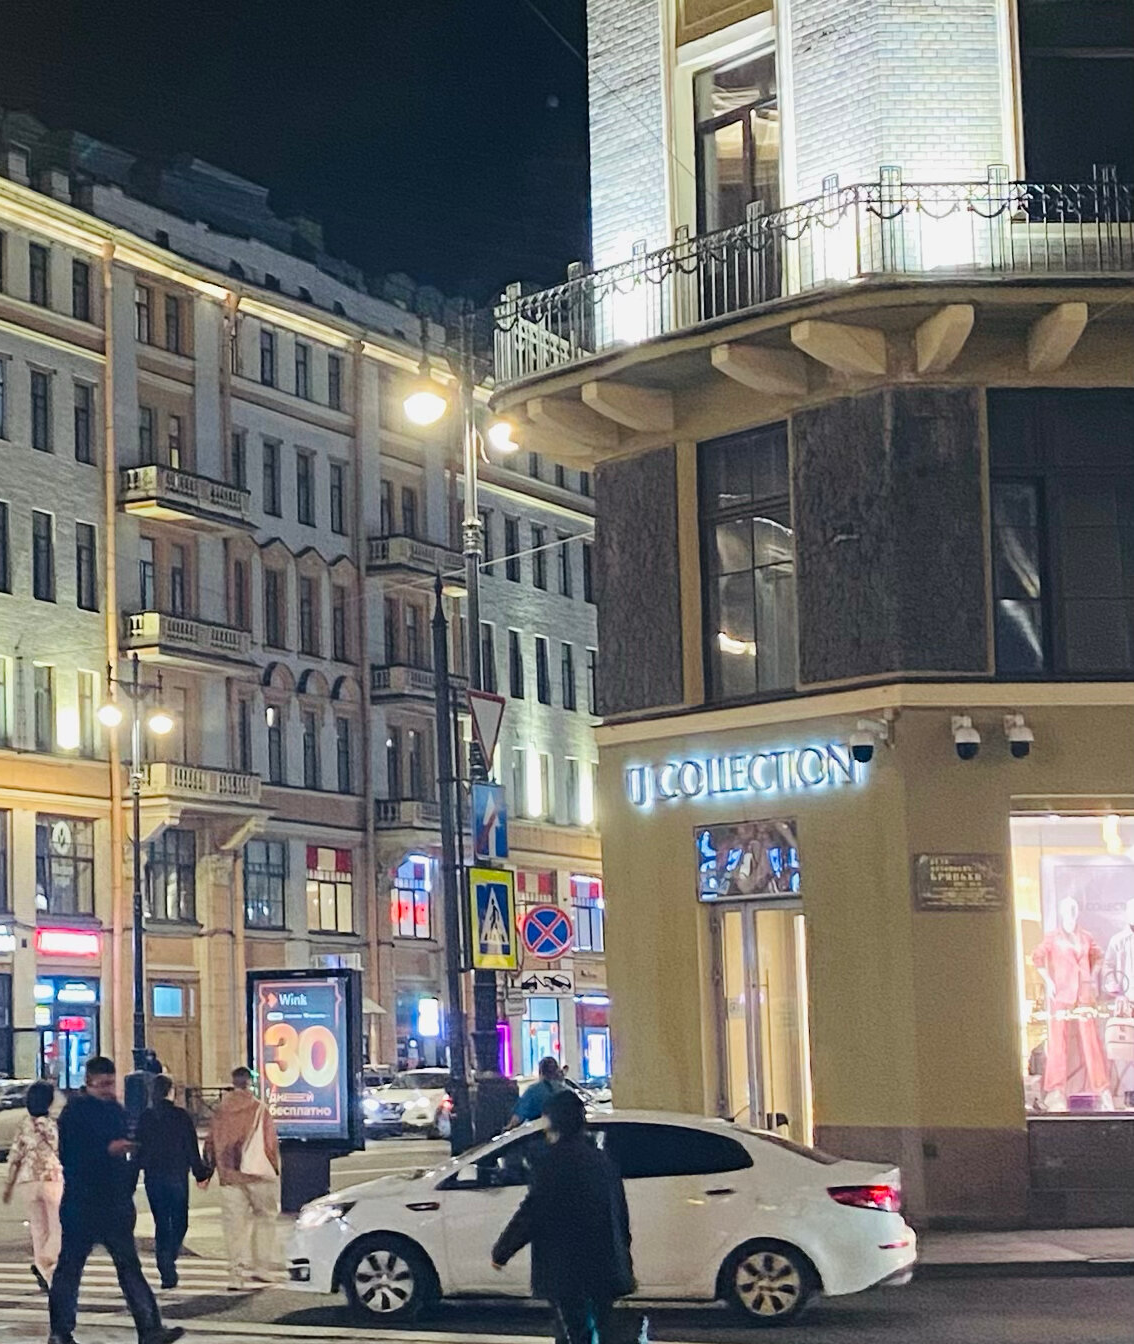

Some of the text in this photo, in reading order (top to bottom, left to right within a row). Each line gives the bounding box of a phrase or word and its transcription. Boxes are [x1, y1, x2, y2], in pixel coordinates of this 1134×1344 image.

[658, 743, 864, 800] COLLECTION
[279, 993, 307, 1006] Wink
[264, 1023, 338, 1087] 30
[268, 1104, 332, 1116] бесплатно
